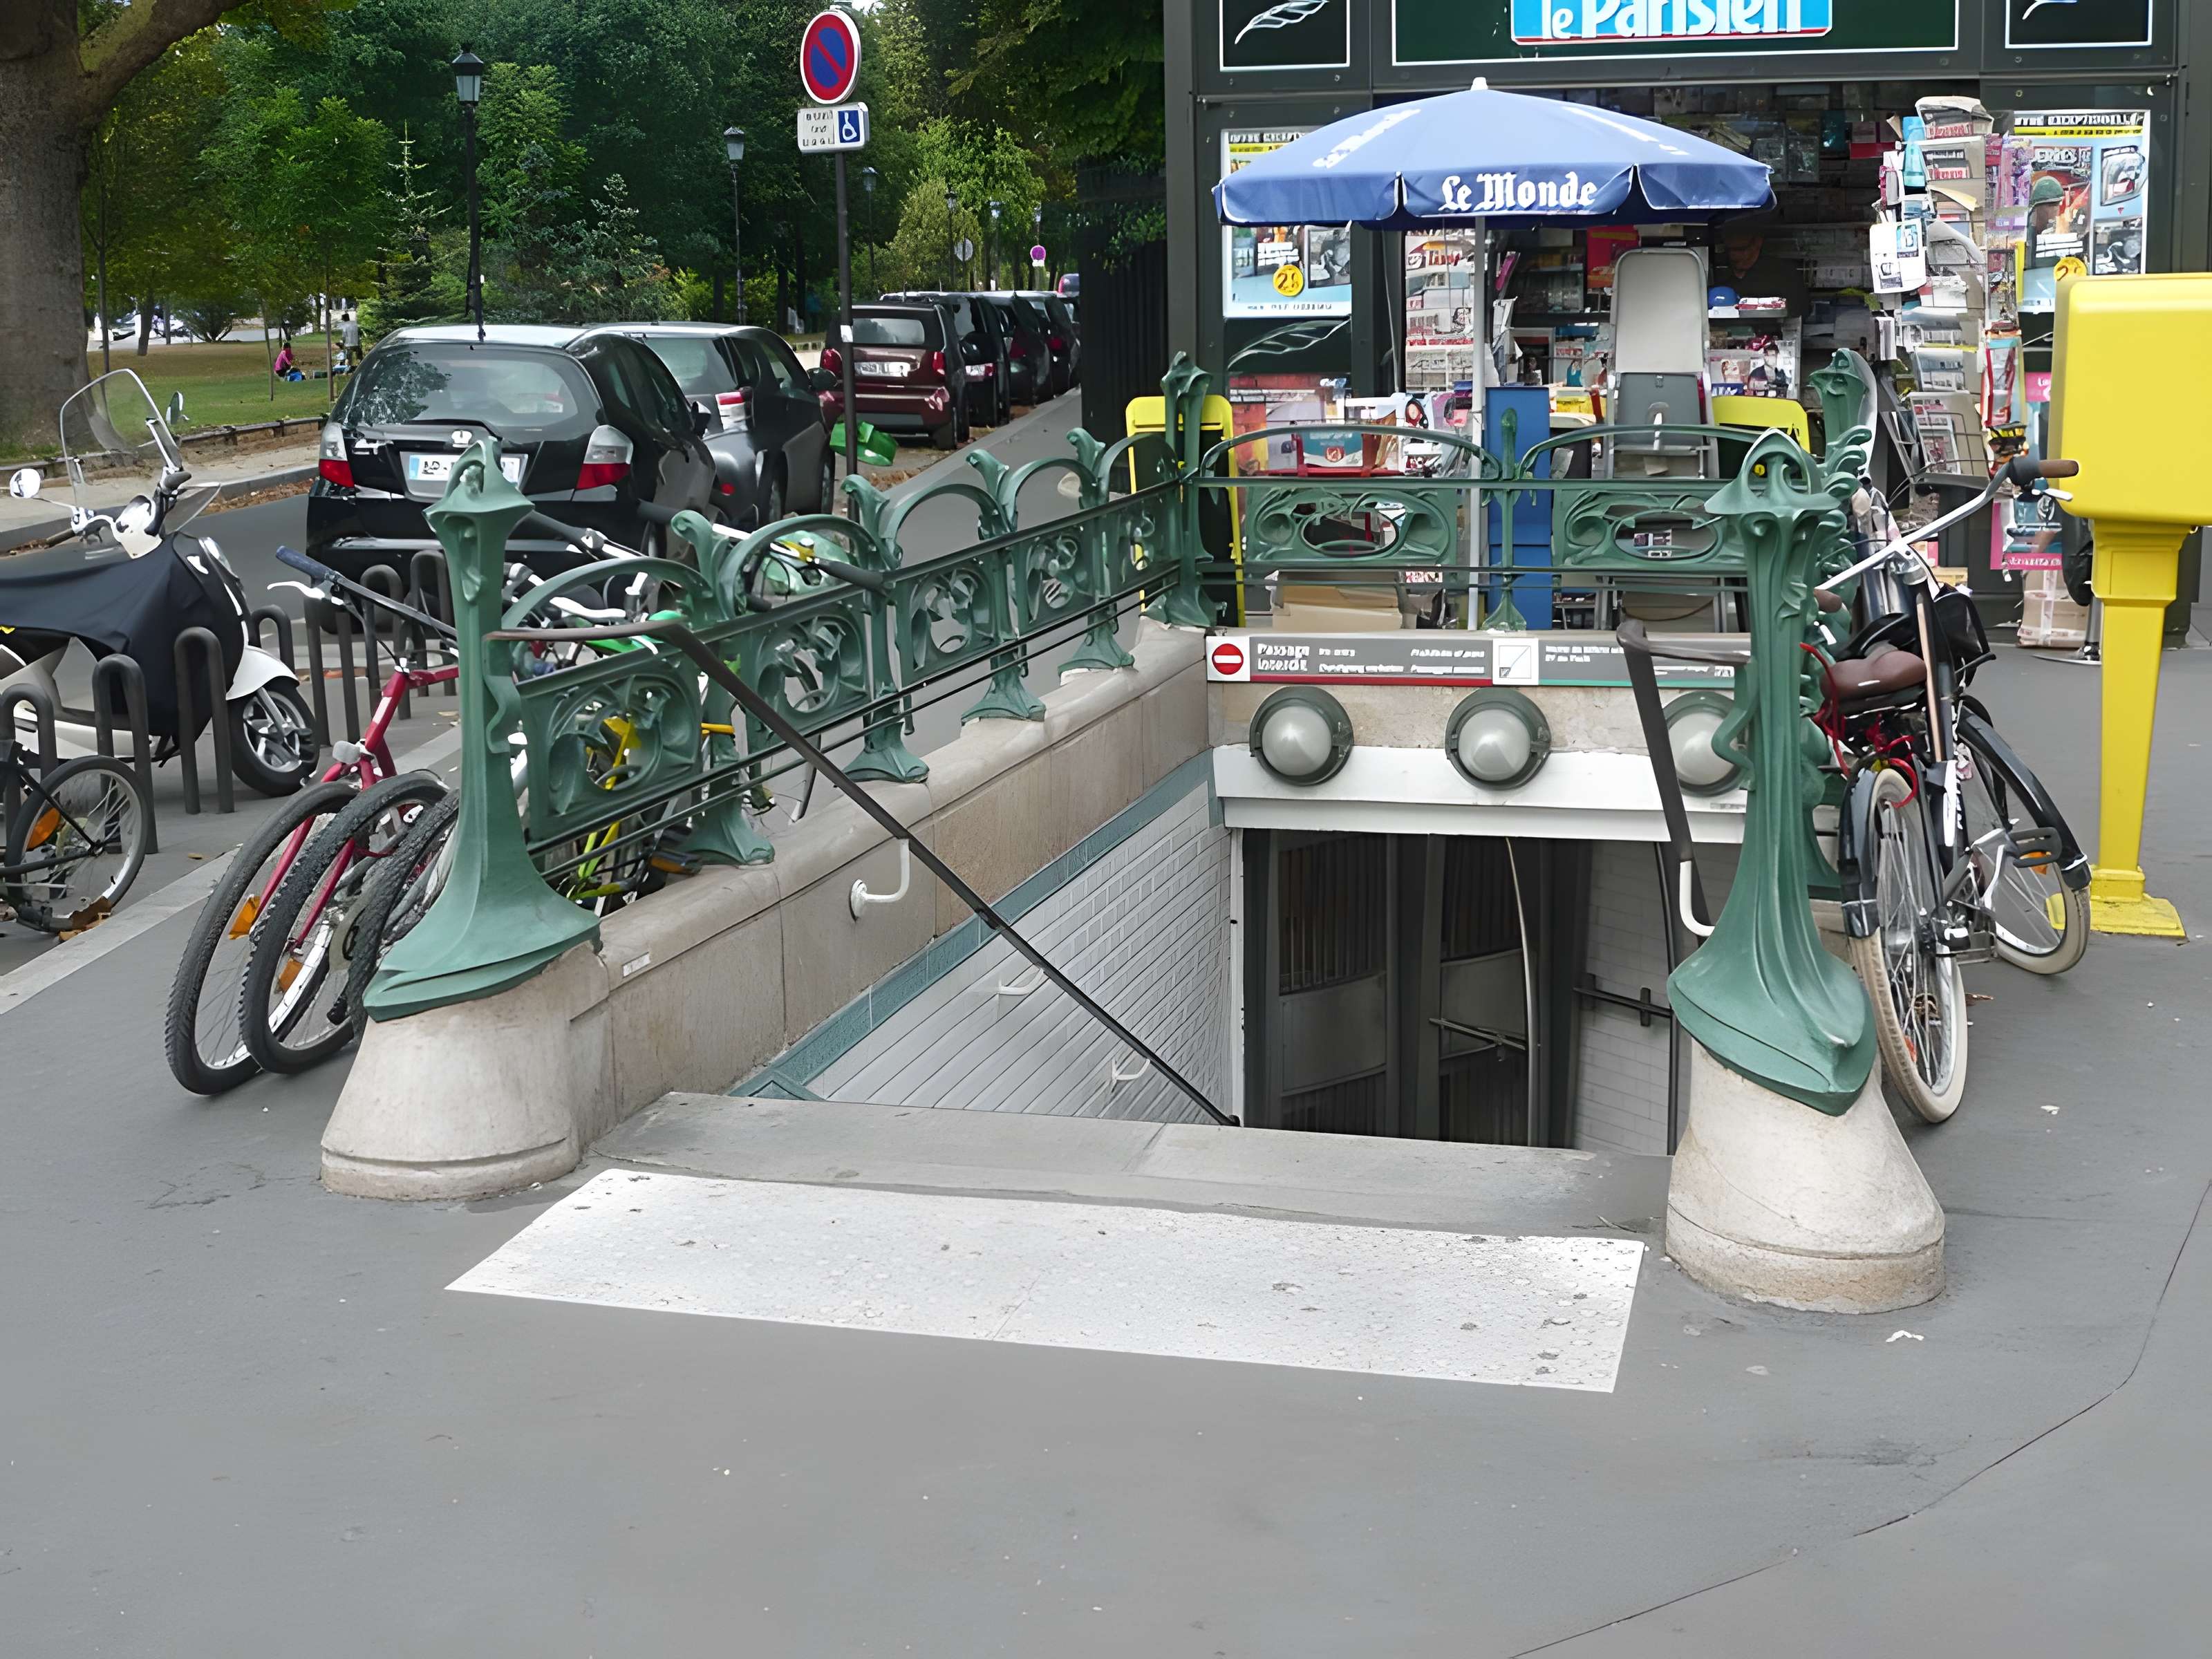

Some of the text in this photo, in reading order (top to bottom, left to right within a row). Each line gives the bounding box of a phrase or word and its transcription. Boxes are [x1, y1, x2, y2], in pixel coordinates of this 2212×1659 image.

[1541, 0, 1574, 39] le
[1438, 171, 1597, 211] Le Monde
